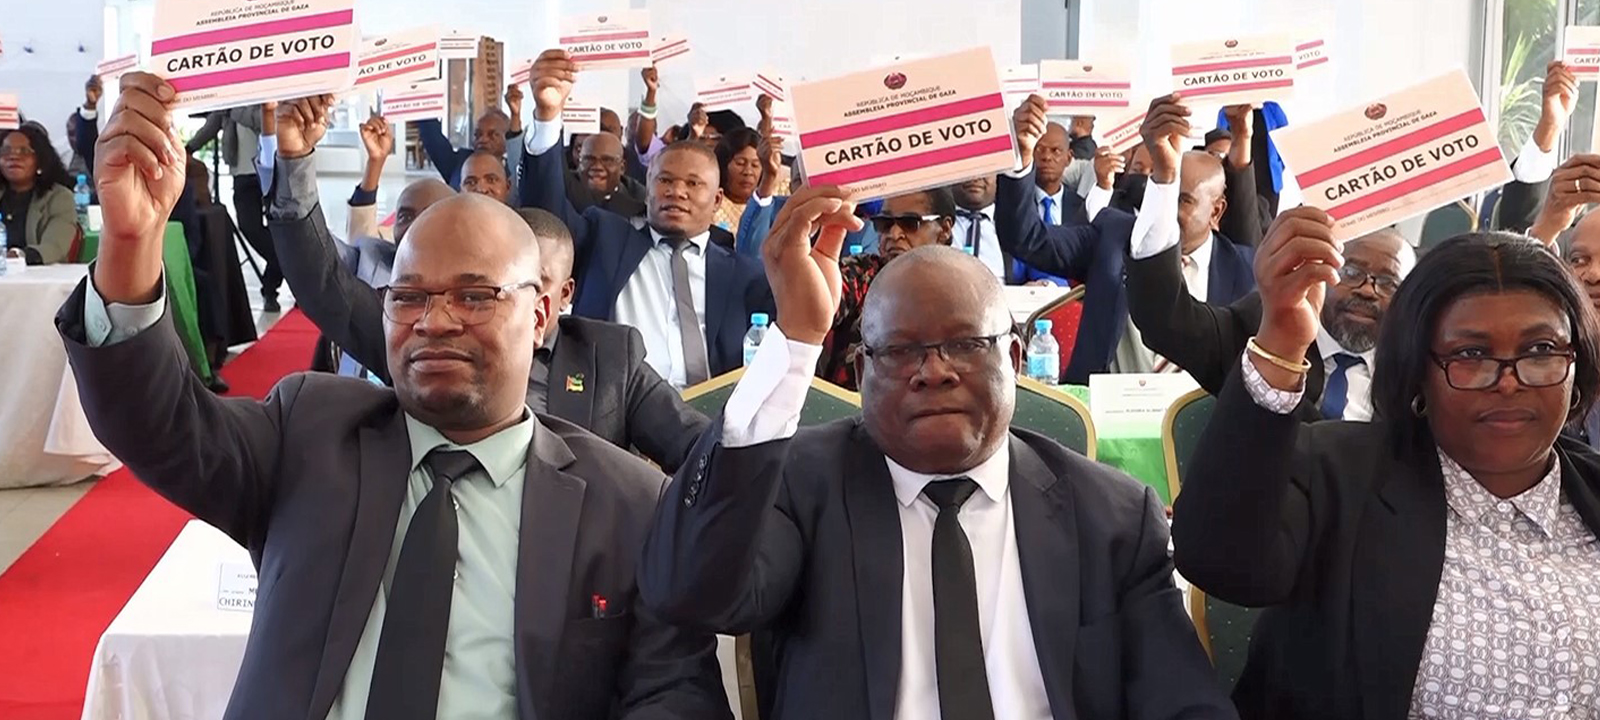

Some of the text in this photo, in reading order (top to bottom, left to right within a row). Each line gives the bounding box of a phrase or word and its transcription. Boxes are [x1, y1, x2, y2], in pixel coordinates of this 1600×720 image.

[196, 15, 236, 26] ASSEMBLEIA
[238, 9, 278, 19] PROVINCIAL
[167, 46, 242, 72] CARTÃO
[250, 44, 274, 60] DE
[281, 34, 335, 55] VOTO
[618, 41, 642, 50] VOTO
[378, 62, 392, 71] DE
[396, 54, 426, 66] VOTO
[1183, 68, 1284, 86] CARTÃO DE VOTO
[844, 105, 884, 118] ASSEMBLEIA
[886, 96, 926, 108] PROVINCIAL
[939, 90, 956, 98] GAZA
[824, 118, 992, 165] CARTÃO DE VOTO
[1334, 136, 1372, 153] ASSEMBLEIA
[1372, 121, 1410, 138] PROVINCIAL
[1324, 134, 1479, 201] CARTÃO DE VOTO
[219, 597, 254, 607] CHIRIN
